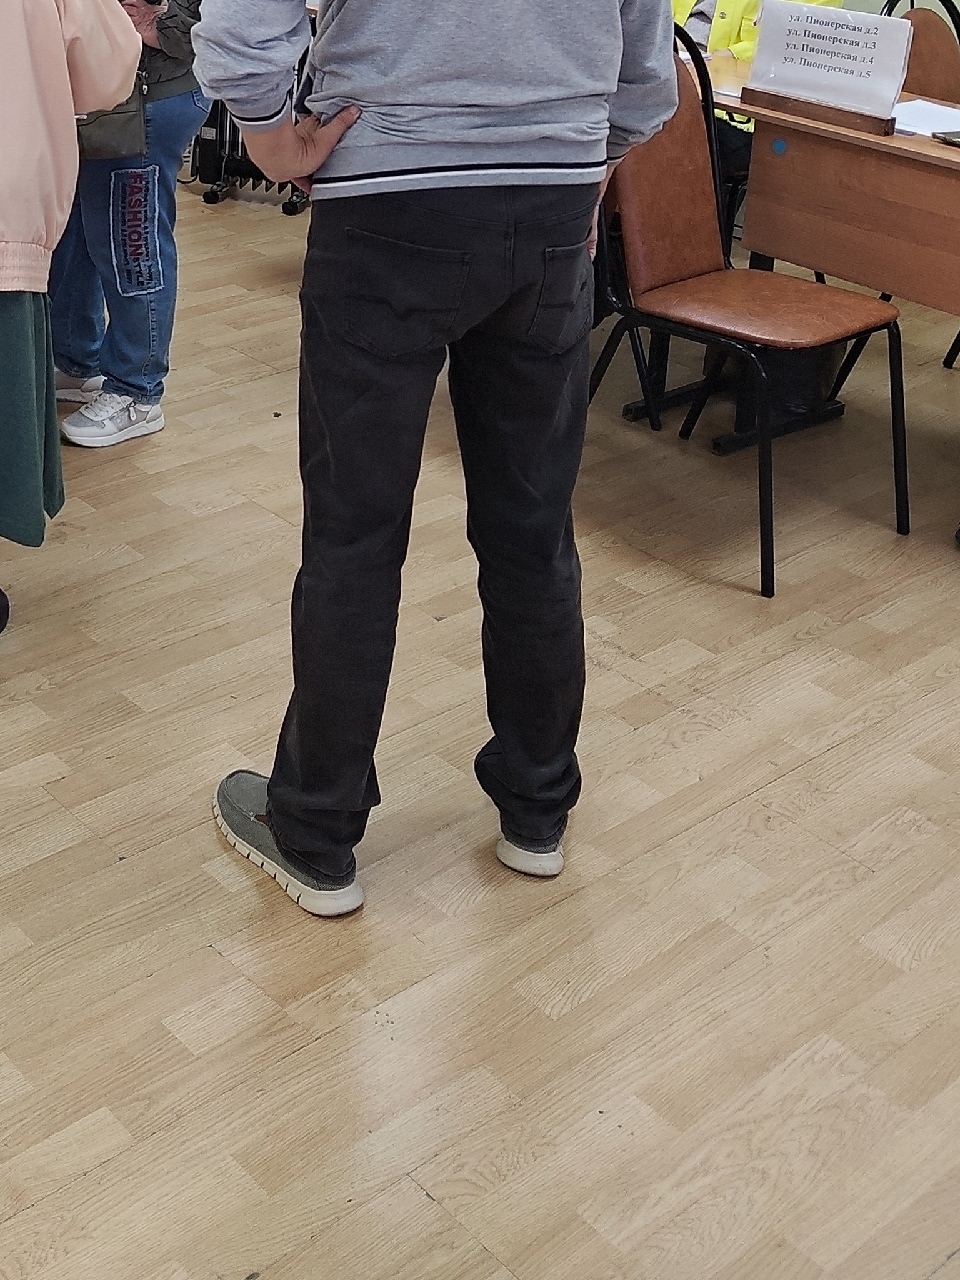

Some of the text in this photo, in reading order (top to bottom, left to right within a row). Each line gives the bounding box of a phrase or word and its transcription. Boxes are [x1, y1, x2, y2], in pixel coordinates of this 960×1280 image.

[788, 14, 879, 36] ул. Пионерская д.2
[787, 28, 876, 49] ул. Пионерская д.3
[785, 42, 874, 64] ул. Пионерская д.4
[782, 56, 871, 78] ул. Пионерская д.5
[126, 173, 144, 257] FASHION
[132, 257, 145, 287] STYLE
